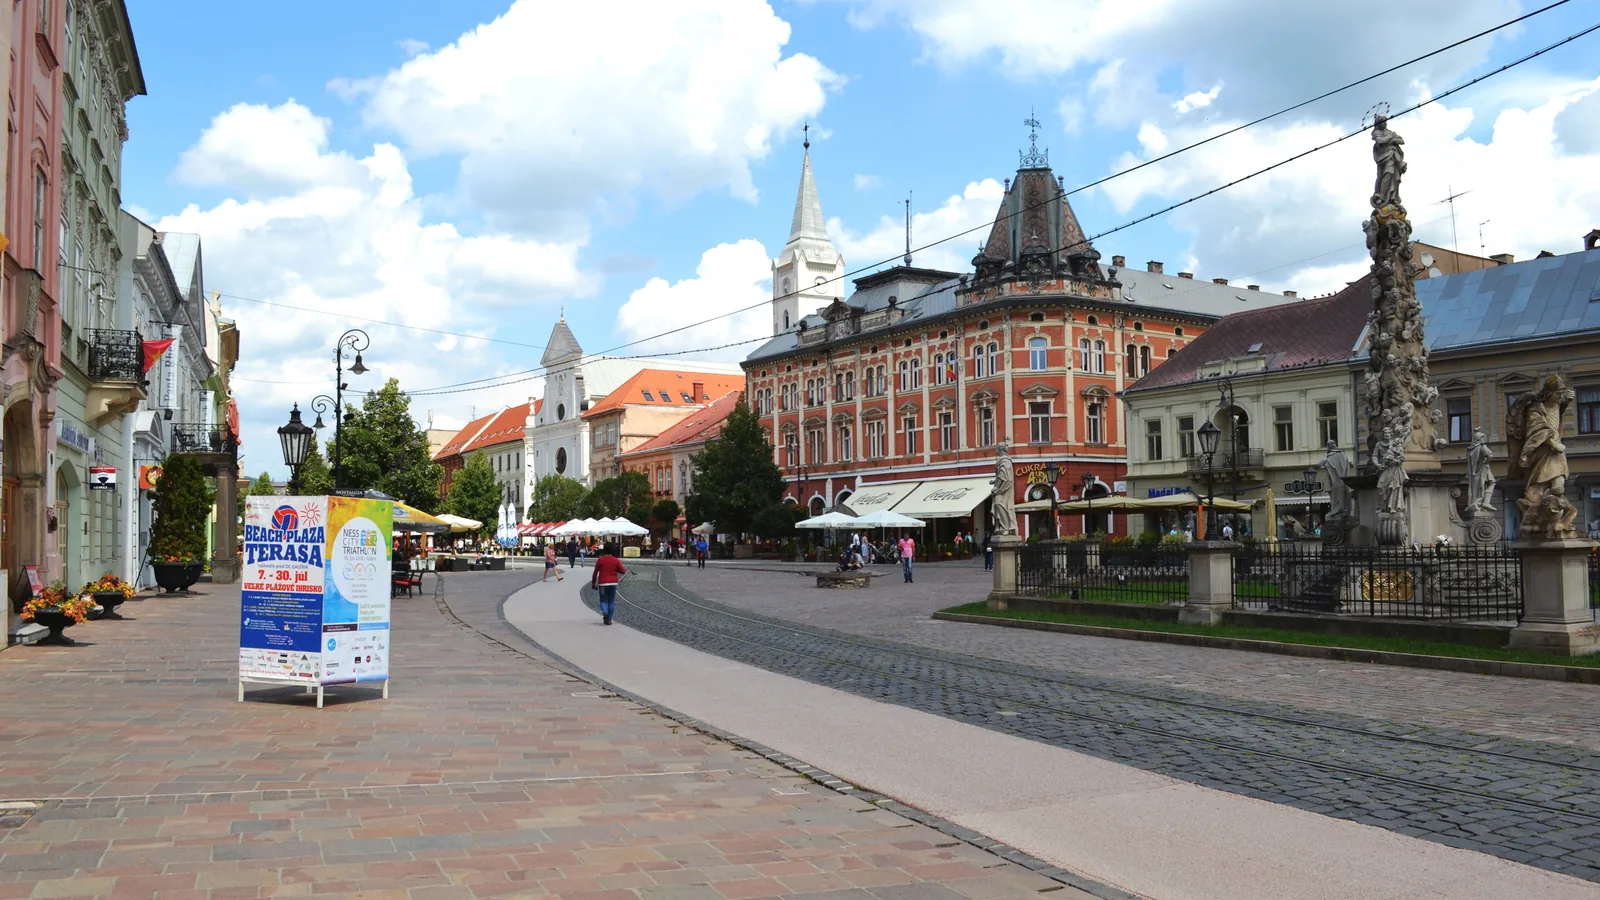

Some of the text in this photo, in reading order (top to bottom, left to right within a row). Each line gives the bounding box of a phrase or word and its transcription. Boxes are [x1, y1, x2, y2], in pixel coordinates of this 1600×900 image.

[245, 525, 325, 543] BEACH PLAZA
[343, 529, 360, 538] NESS
[343, 537, 359, 546] CITY
[343, 546, 377, 555] TRIATHLON
[245, 543, 323, 568] TERASA
[258, 569, 266, 580] 7.
[276, 570, 292, 581] 30.
[295, 571, 308, 583] júl
[296, 585, 322, 593] IHRISKO
